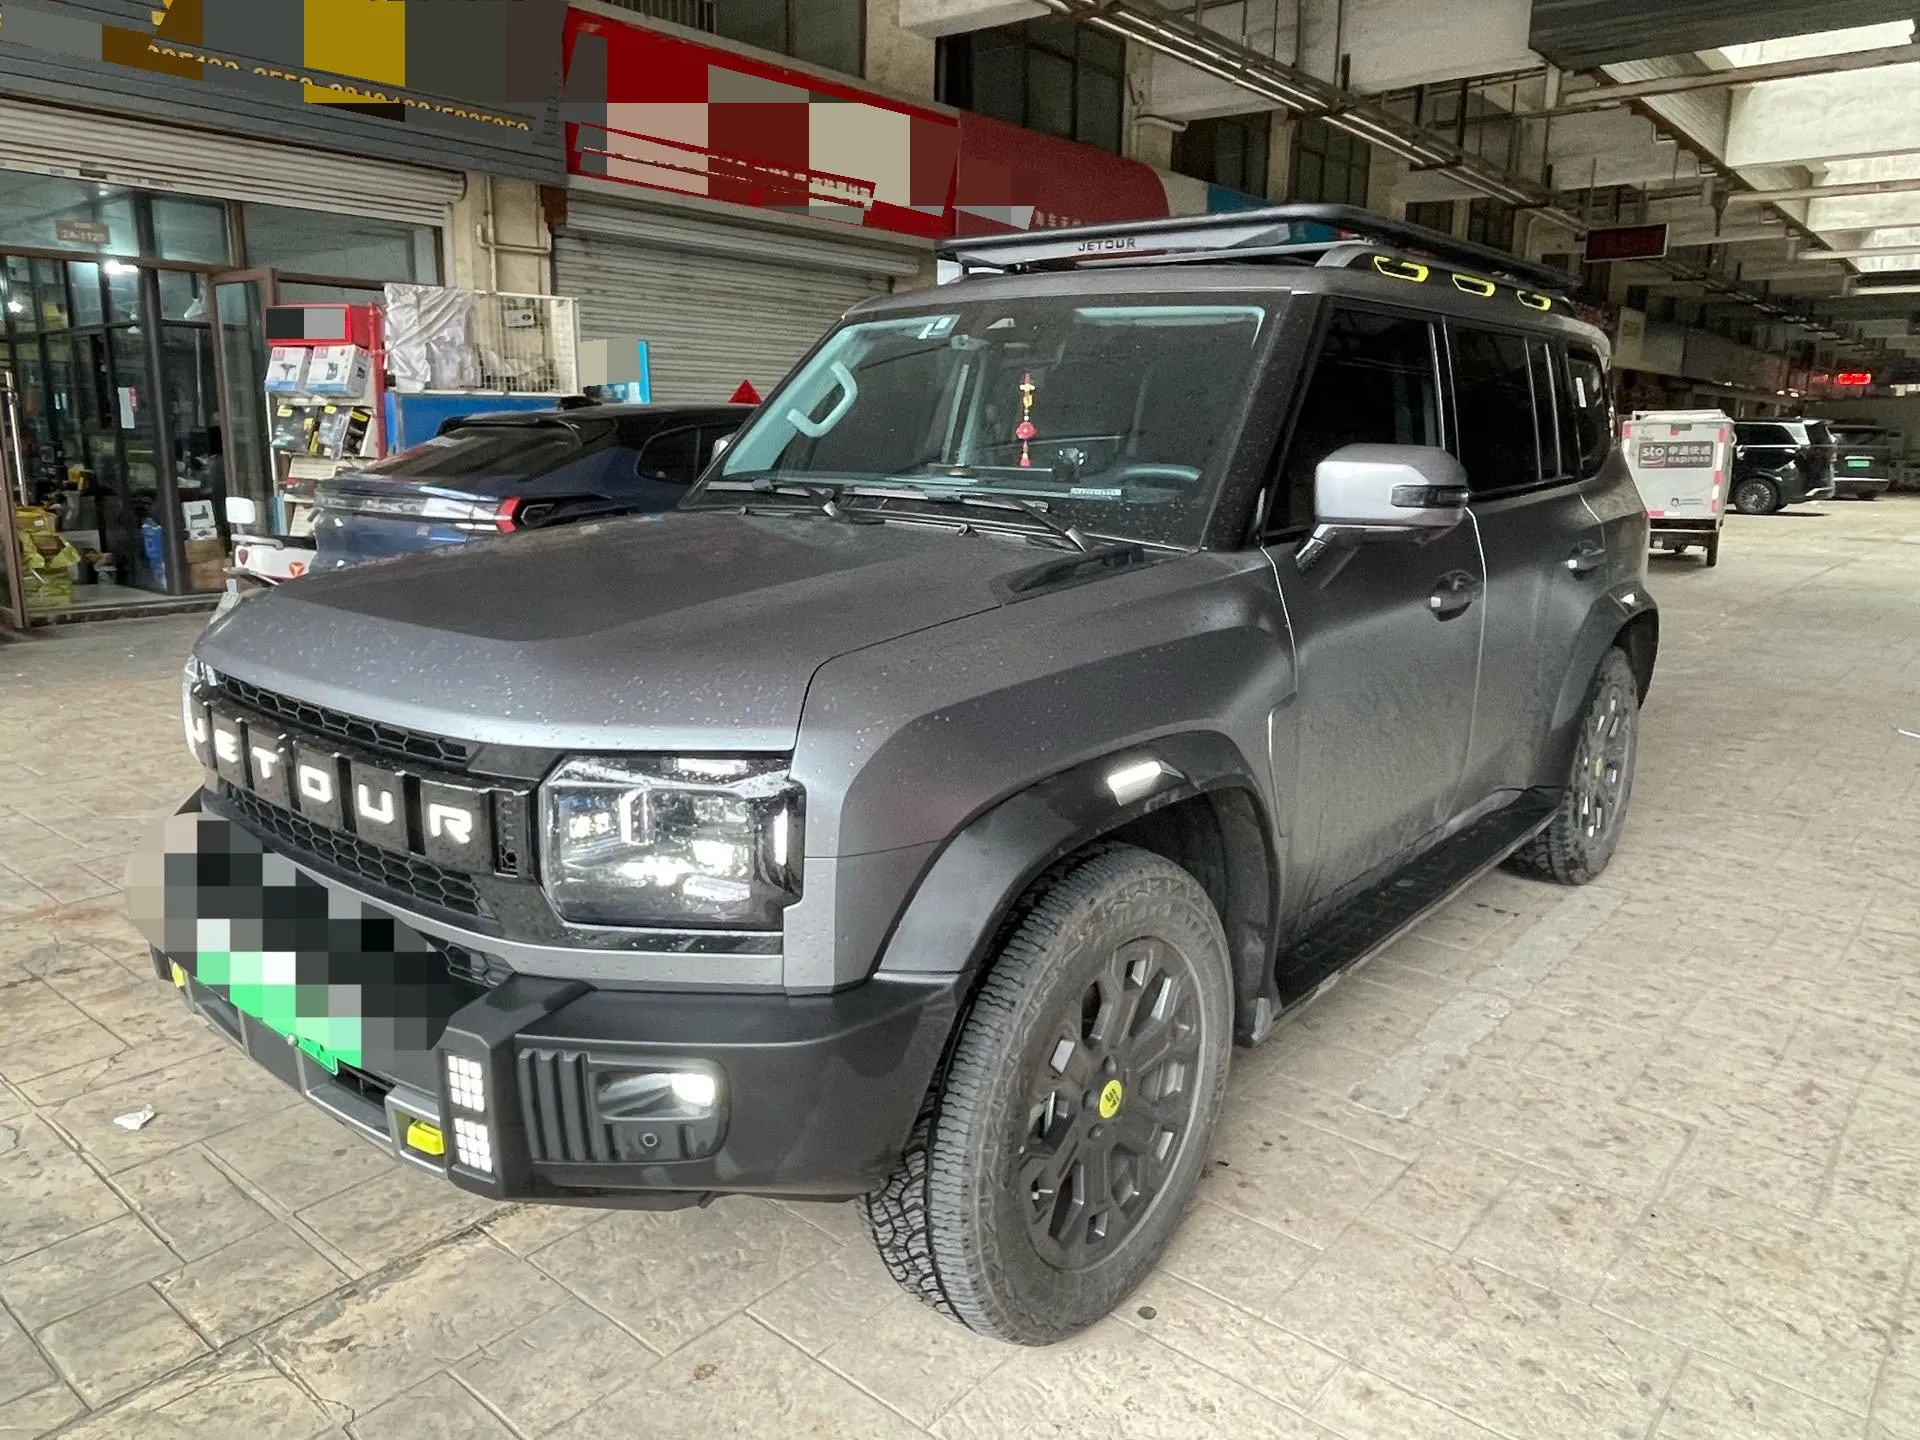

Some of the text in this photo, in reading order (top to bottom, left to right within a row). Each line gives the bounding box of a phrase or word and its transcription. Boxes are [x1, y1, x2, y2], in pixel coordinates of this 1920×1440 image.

[1078, 237, 1136, 251] JETOUR
[1641, 446, 1665, 457] sto
[1668, 456, 1710, 464] express
[190, 717, 473, 845] JETOUR
